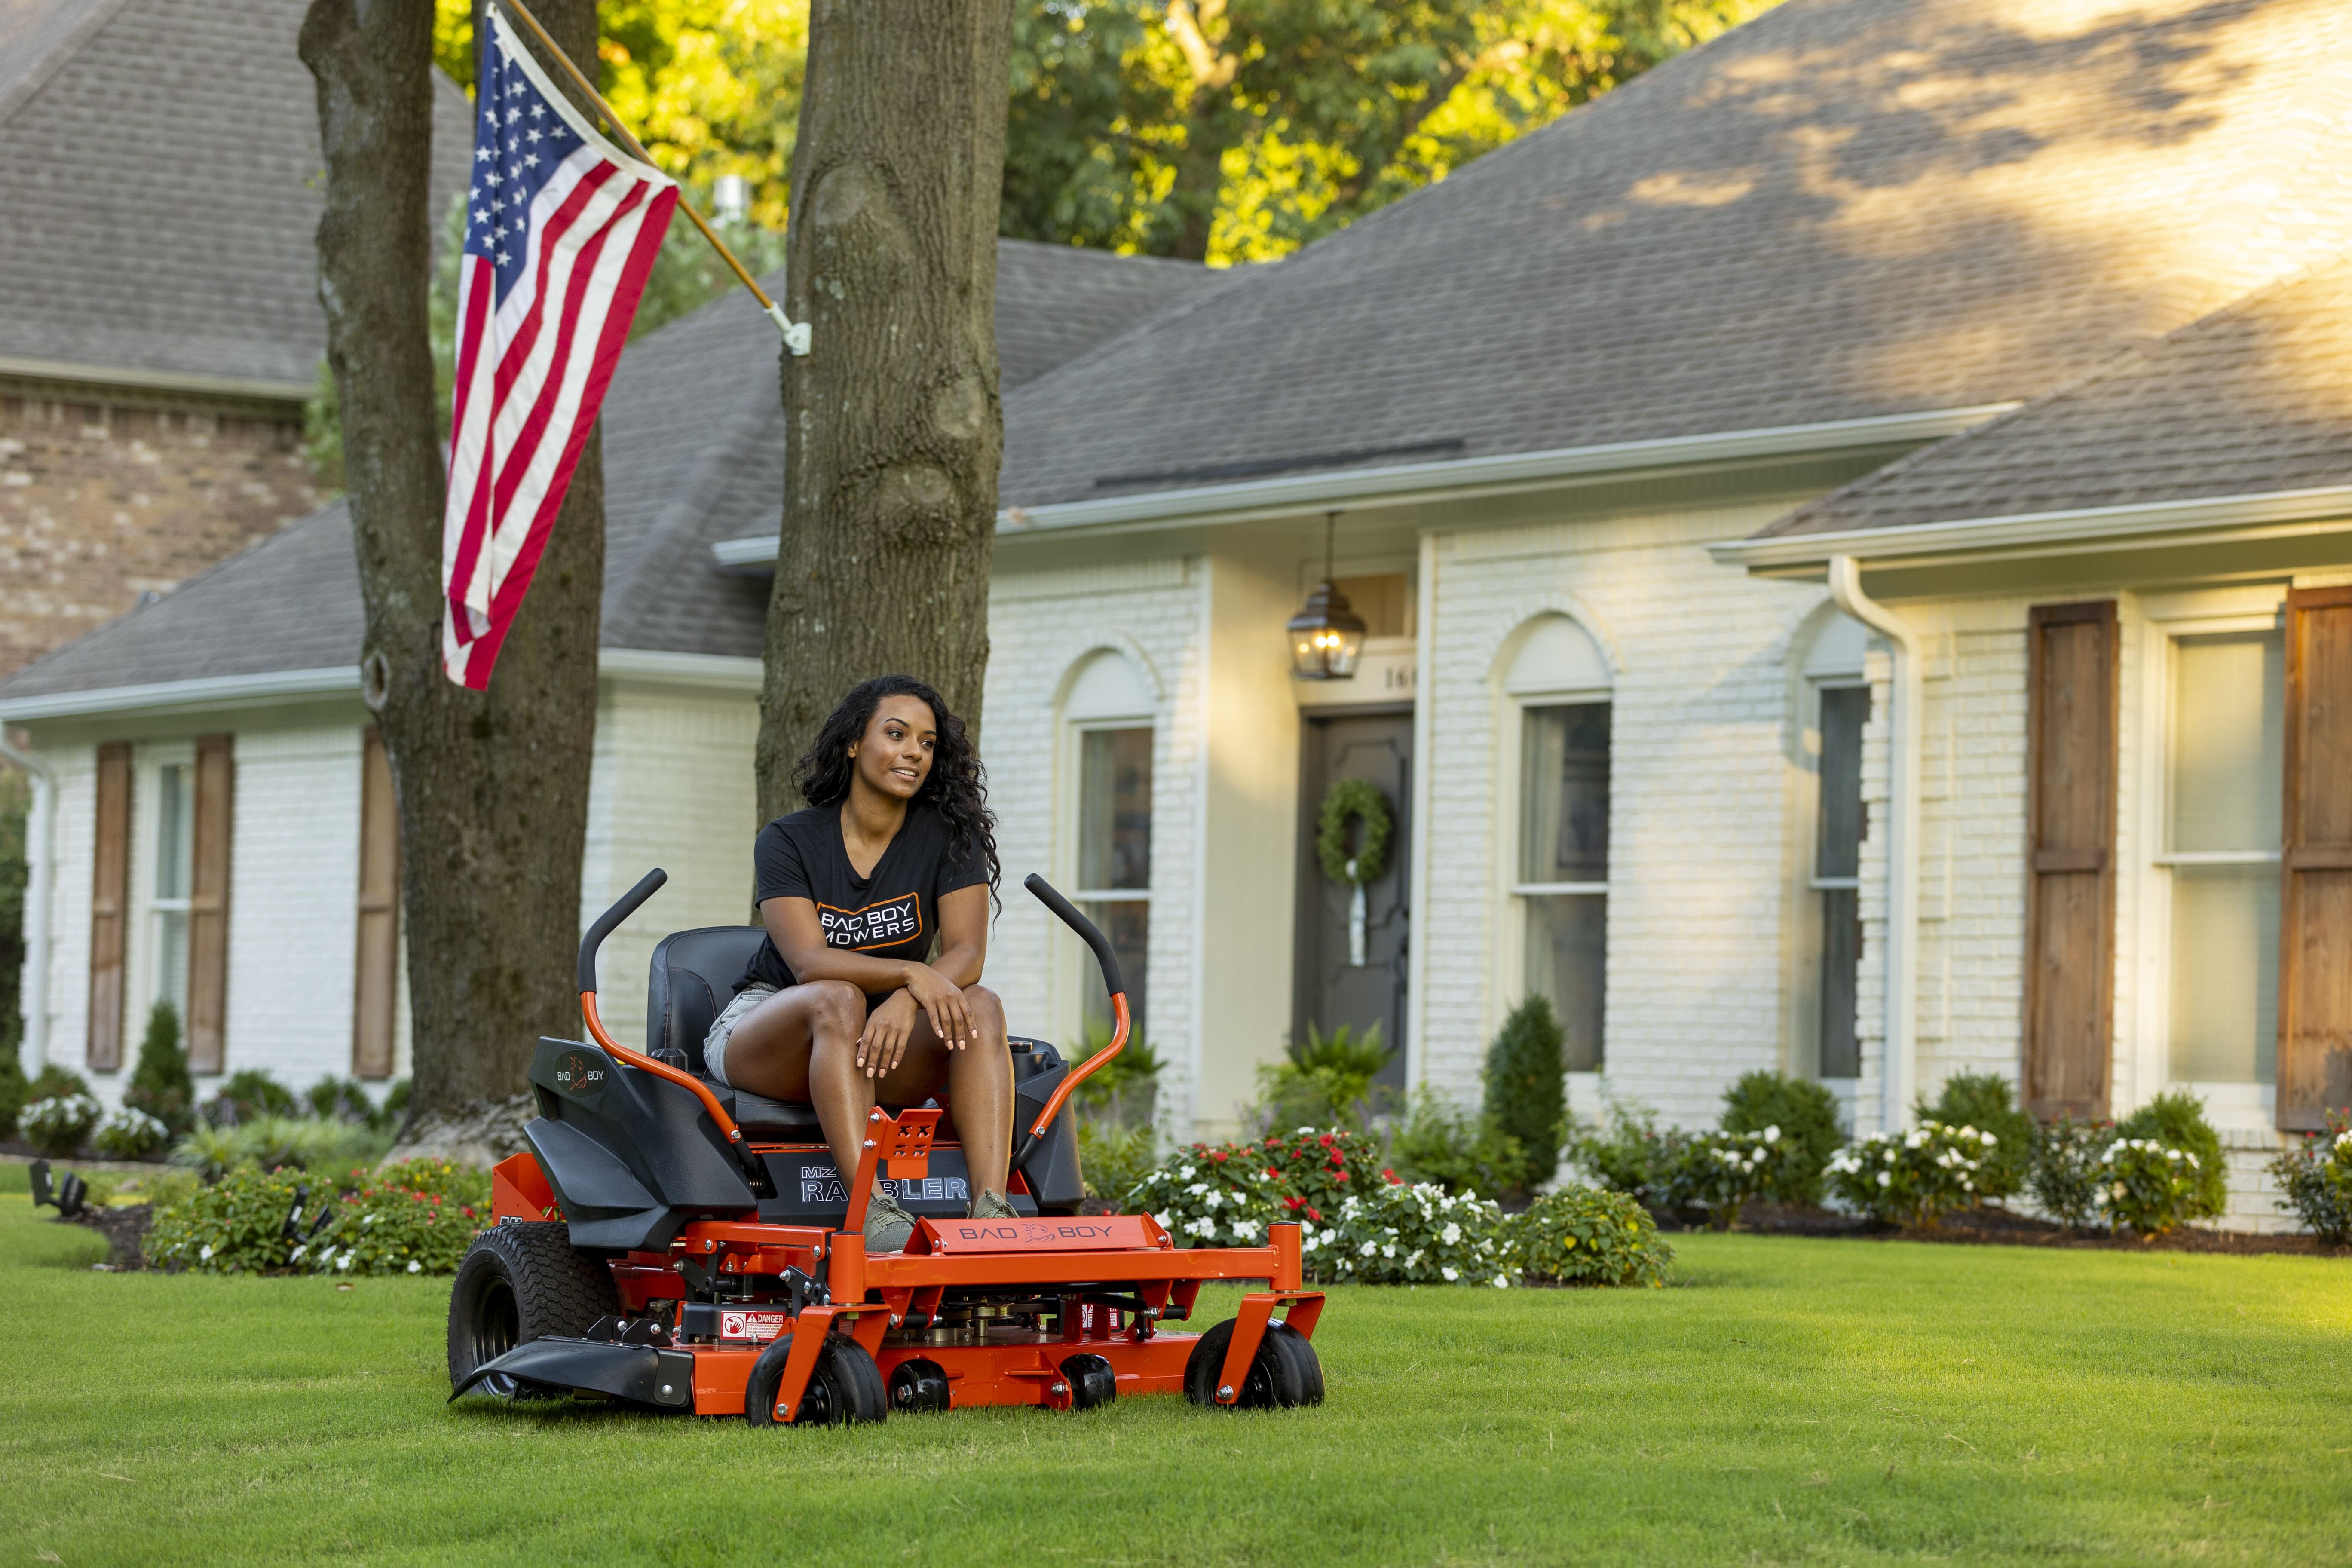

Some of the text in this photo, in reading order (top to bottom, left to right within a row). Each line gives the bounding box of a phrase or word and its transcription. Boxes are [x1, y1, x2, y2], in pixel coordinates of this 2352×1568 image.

[821, 902, 911, 931] BAD BOY
[823, 917, 914, 944] MOWERS
[557, 1070, 603, 1081] BAD BOY
[801, 1166, 837, 1178] MZ
[802, 1177, 970, 1202] RABLER
[959, 1226, 1112, 1240] BAD BOY
[758, 1314, 783, 1323] DANGER
